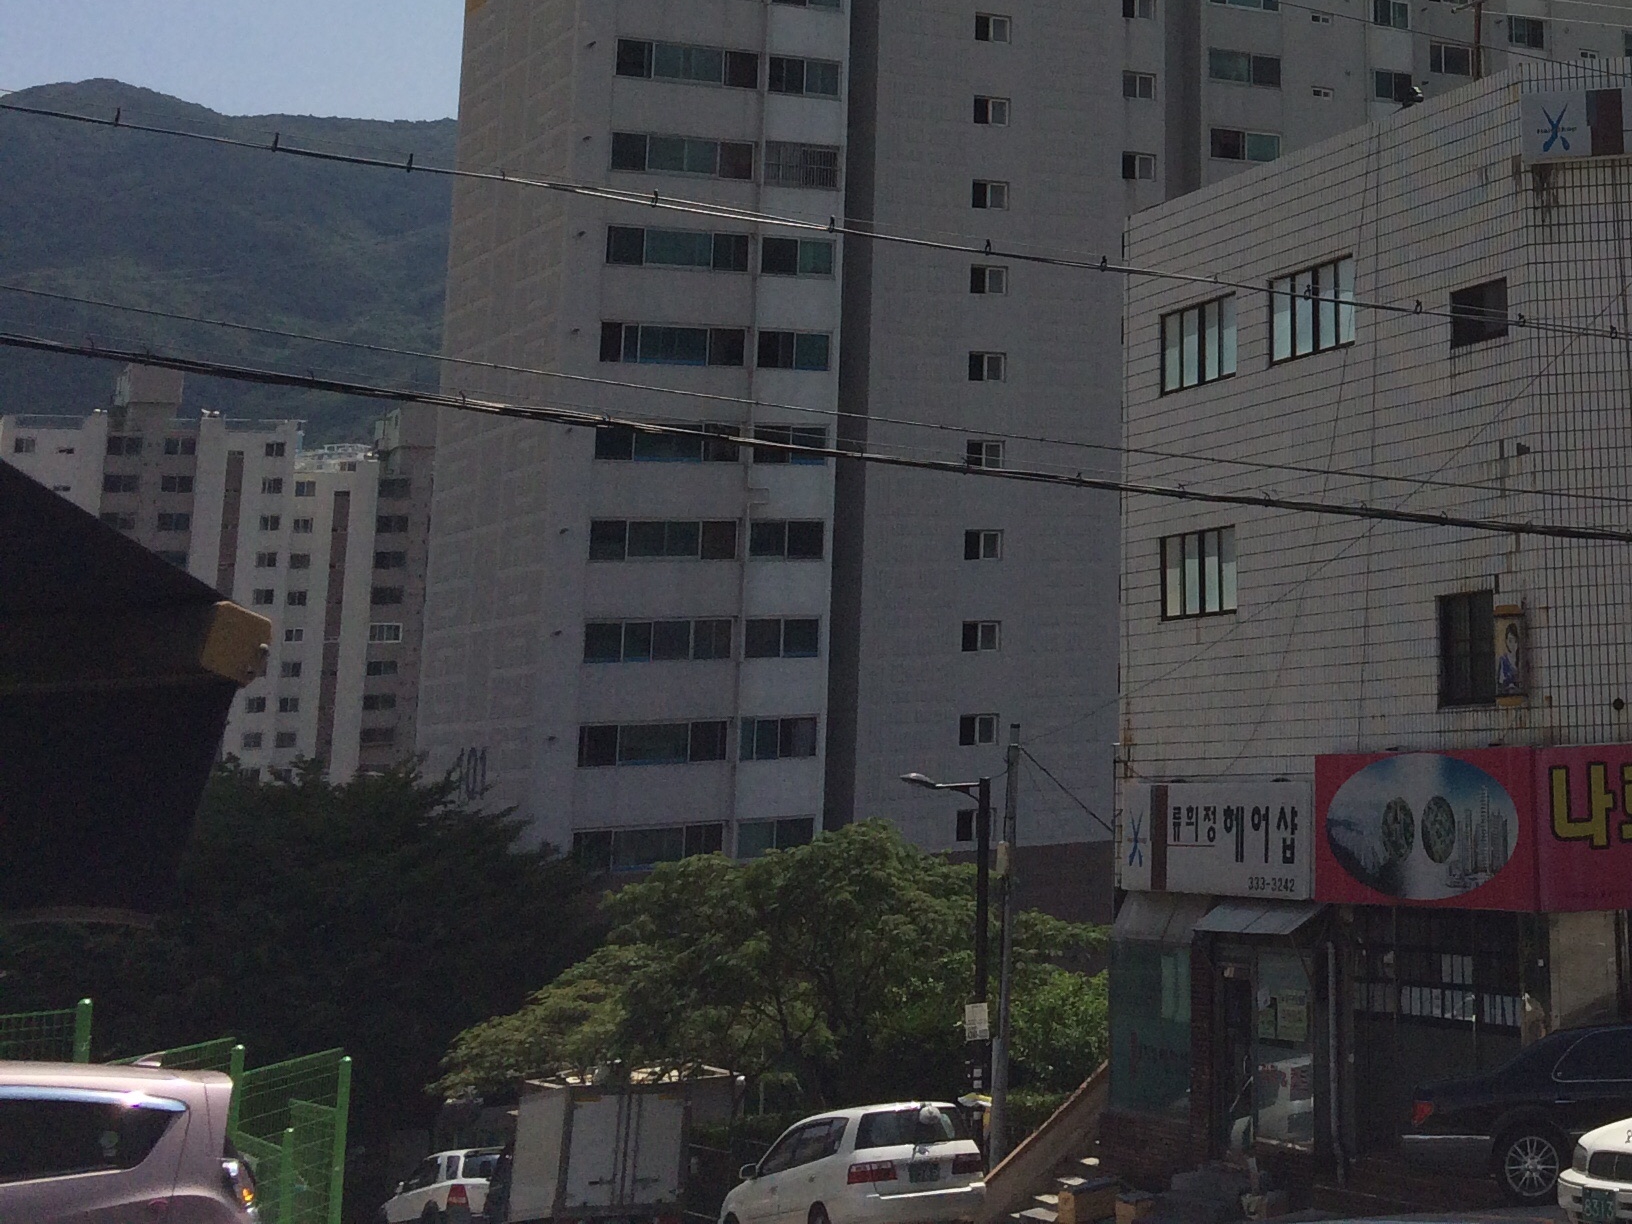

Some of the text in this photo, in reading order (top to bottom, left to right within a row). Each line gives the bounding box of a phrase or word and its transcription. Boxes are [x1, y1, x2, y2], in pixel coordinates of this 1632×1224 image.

[1172, 804, 1299, 865] 류희정 헤어샵
[1247, 875, 1296, 893] 333-3242
